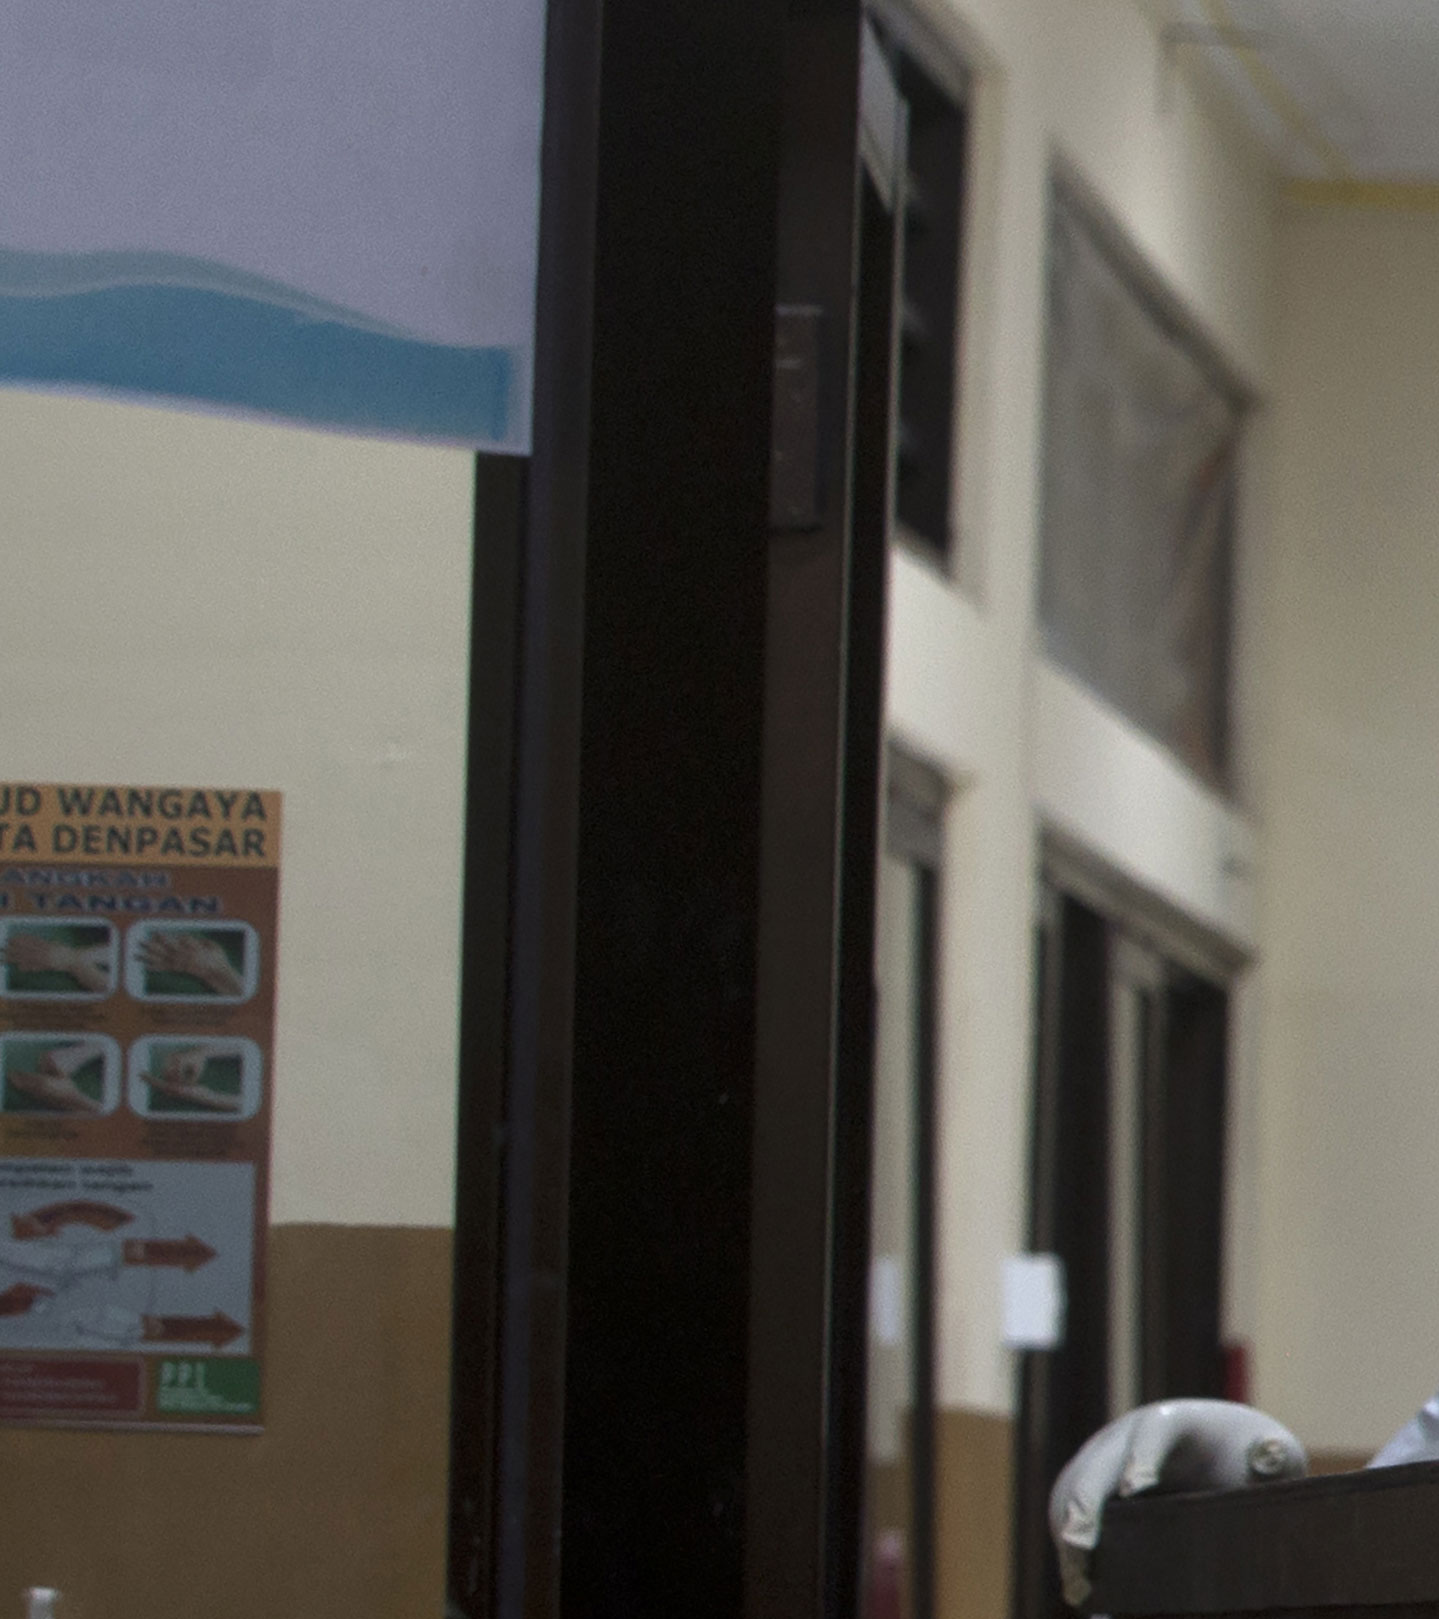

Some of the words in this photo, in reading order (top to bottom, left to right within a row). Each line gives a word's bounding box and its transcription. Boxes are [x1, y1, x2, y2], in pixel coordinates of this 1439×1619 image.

[57, 788, 267, 820] WANGAYA
[52, 825, 266, 857] DENPASAR
[30, 893, 222, 914] TANGAN
